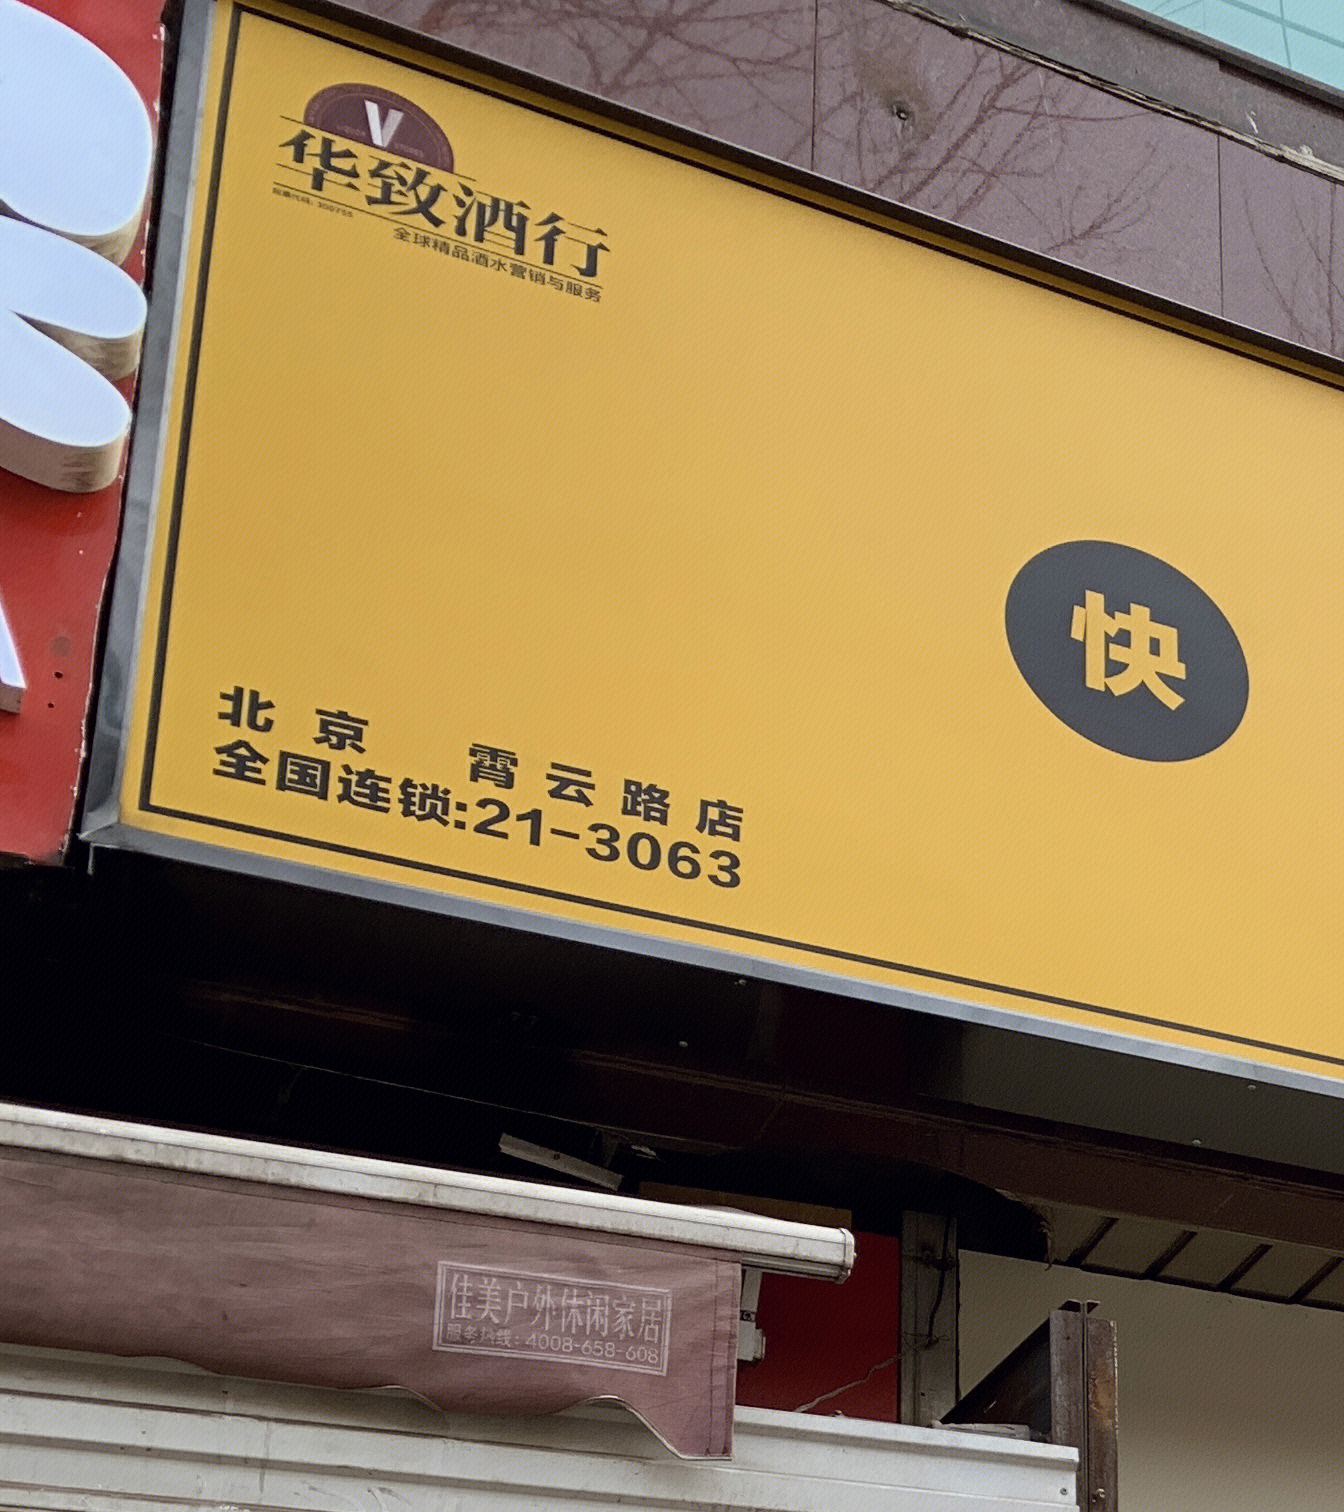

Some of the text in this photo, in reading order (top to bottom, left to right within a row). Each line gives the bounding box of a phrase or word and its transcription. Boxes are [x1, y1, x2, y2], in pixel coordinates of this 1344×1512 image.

[278, 129, 611, 278] 华致酒行
[393, 227, 603, 303] 全球精品酒水营销与服务
[1070, 589, 1188, 711] 快
[213, 739, 742, 889] 全国连锁:21-3063
[217, 685, 744, 842] 北京 霄云路店
[449, 1272, 662, 1344] 佳美户外休闲家居
